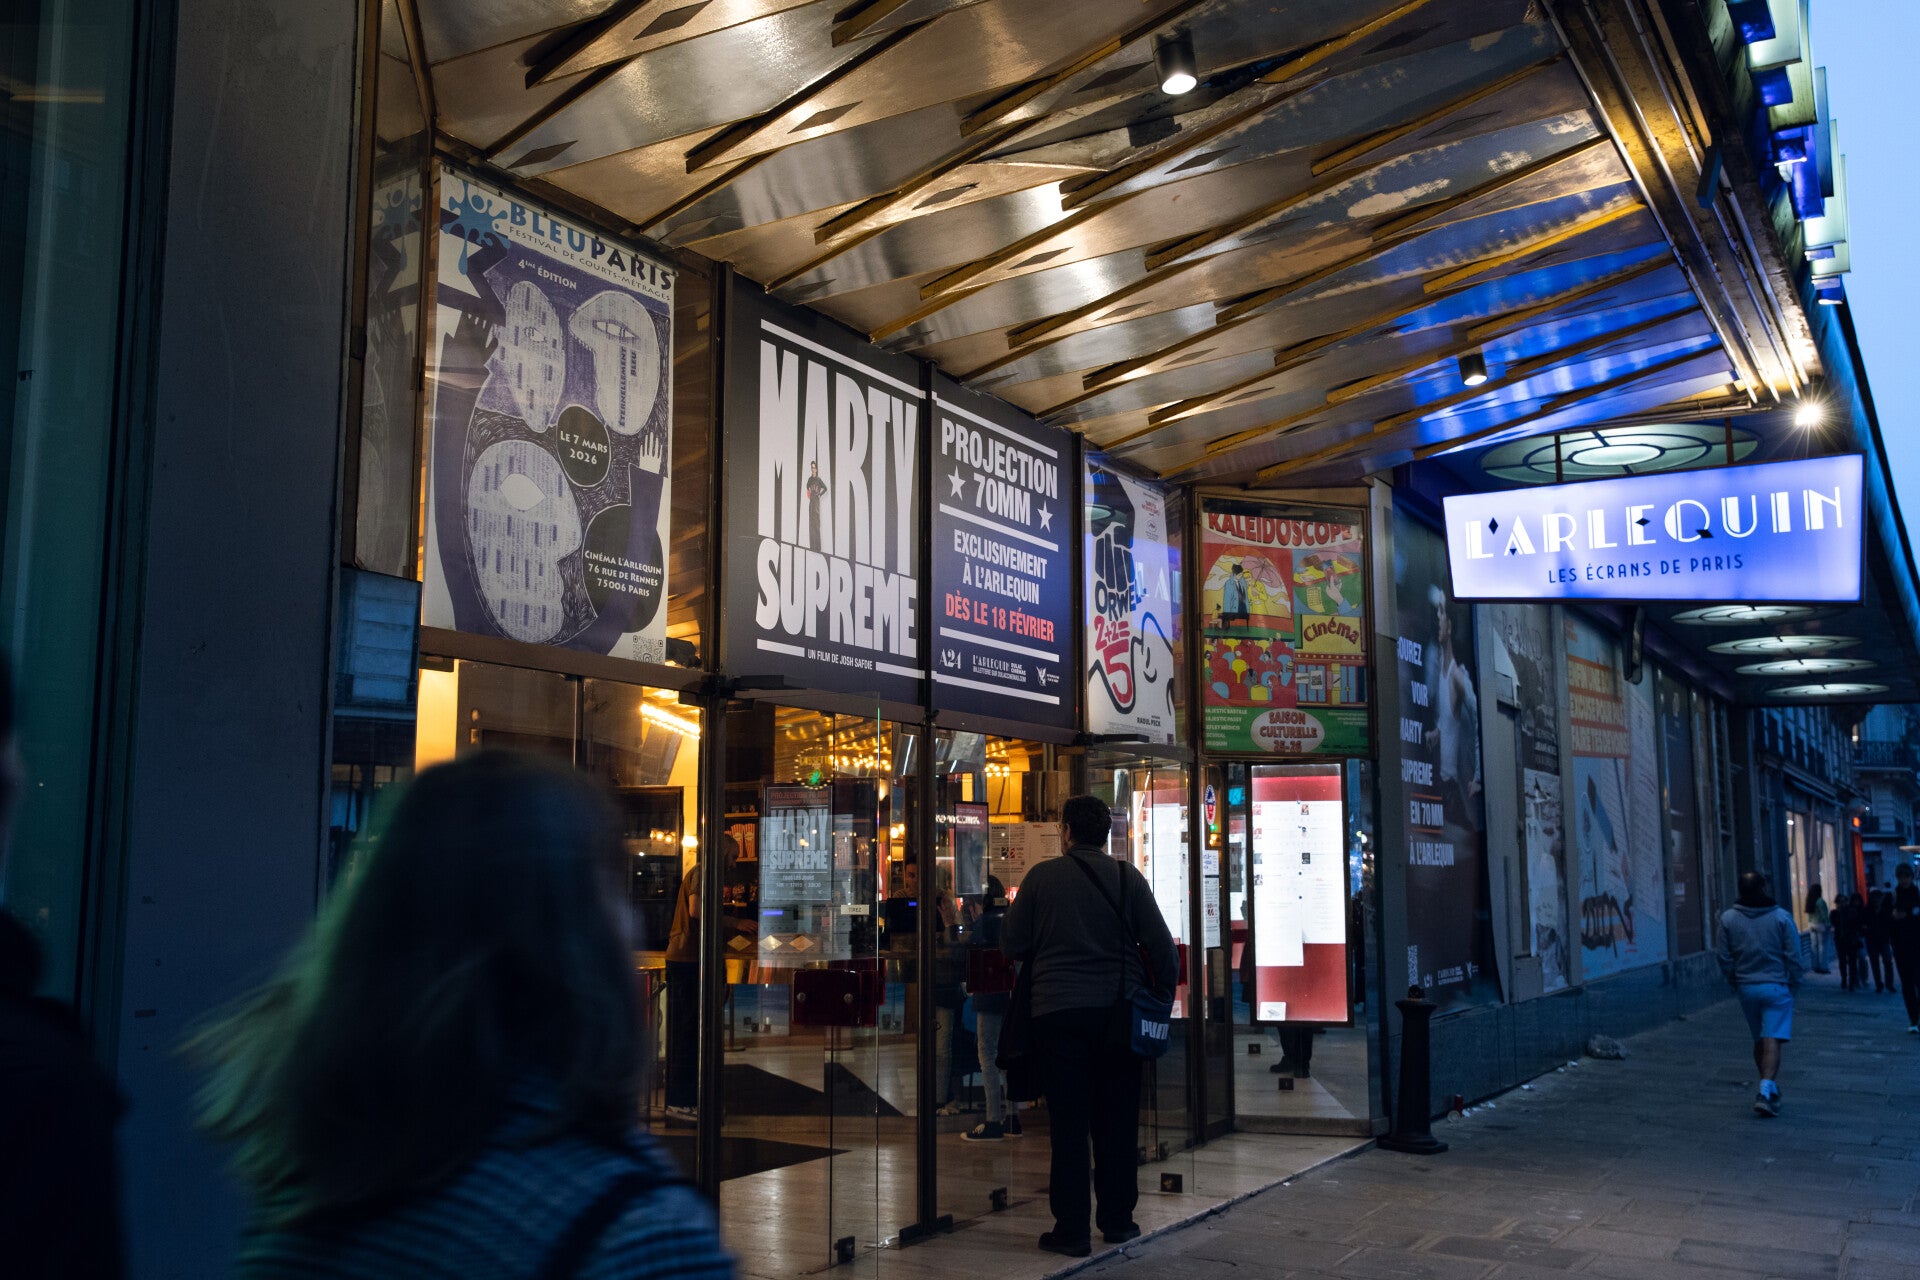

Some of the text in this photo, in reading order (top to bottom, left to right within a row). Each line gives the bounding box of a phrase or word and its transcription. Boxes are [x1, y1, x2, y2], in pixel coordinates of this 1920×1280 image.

[509, 226, 558, 253] FESTIVAL
[562, 250, 575, 261] DE
[537, 266, 577, 290] ÉDITION
[573, 433, 579, 444] 7
[569, 448, 598, 465] 2026
[758, 339, 917, 576] MARTY
[941, 417, 1058, 500] PROJECTION
[973, 472, 1031, 528] 70MM
[1464, 486, 1844, 559] L'ARLEQUIN
[588, 563, 600, 574] 76
[954, 528, 1048, 580] EXCLUSIVEMENT
[962, 557, 1040, 605] À L'ARLEQUIN
[1548, 554, 1744, 584] LES ÉCRANS DE PARIS
[597, 578, 627, 593] 75006
[756, 538, 917, 659] SUPREME
[945, 593, 1055, 643] DÈS LE 18 FÉVRIER
[1302, 616, 1361, 645] Cinéma
[807, 649, 816, 660] UN
[817, 650, 830, 662] FILM
[832, 652, 839, 664] DE
[840, 653, 854, 667] JOSH
[939, 648, 962, 669] A24
[1397, 636, 1423, 667] OUREZ
[1102, 638, 1133, 704] 5
[1411, 680, 1429, 707] VOIR
[1260, 726, 1318, 738] CULTURELLE
[1269, 711, 1306, 725] SAISON
[1410, 800, 1420, 825] EN
[770, 808, 828, 851] MARTY
[769, 850, 828, 870] SUPREME
[1409, 834, 1416, 865] À
[1141, 1018, 1169, 1040] PUM
